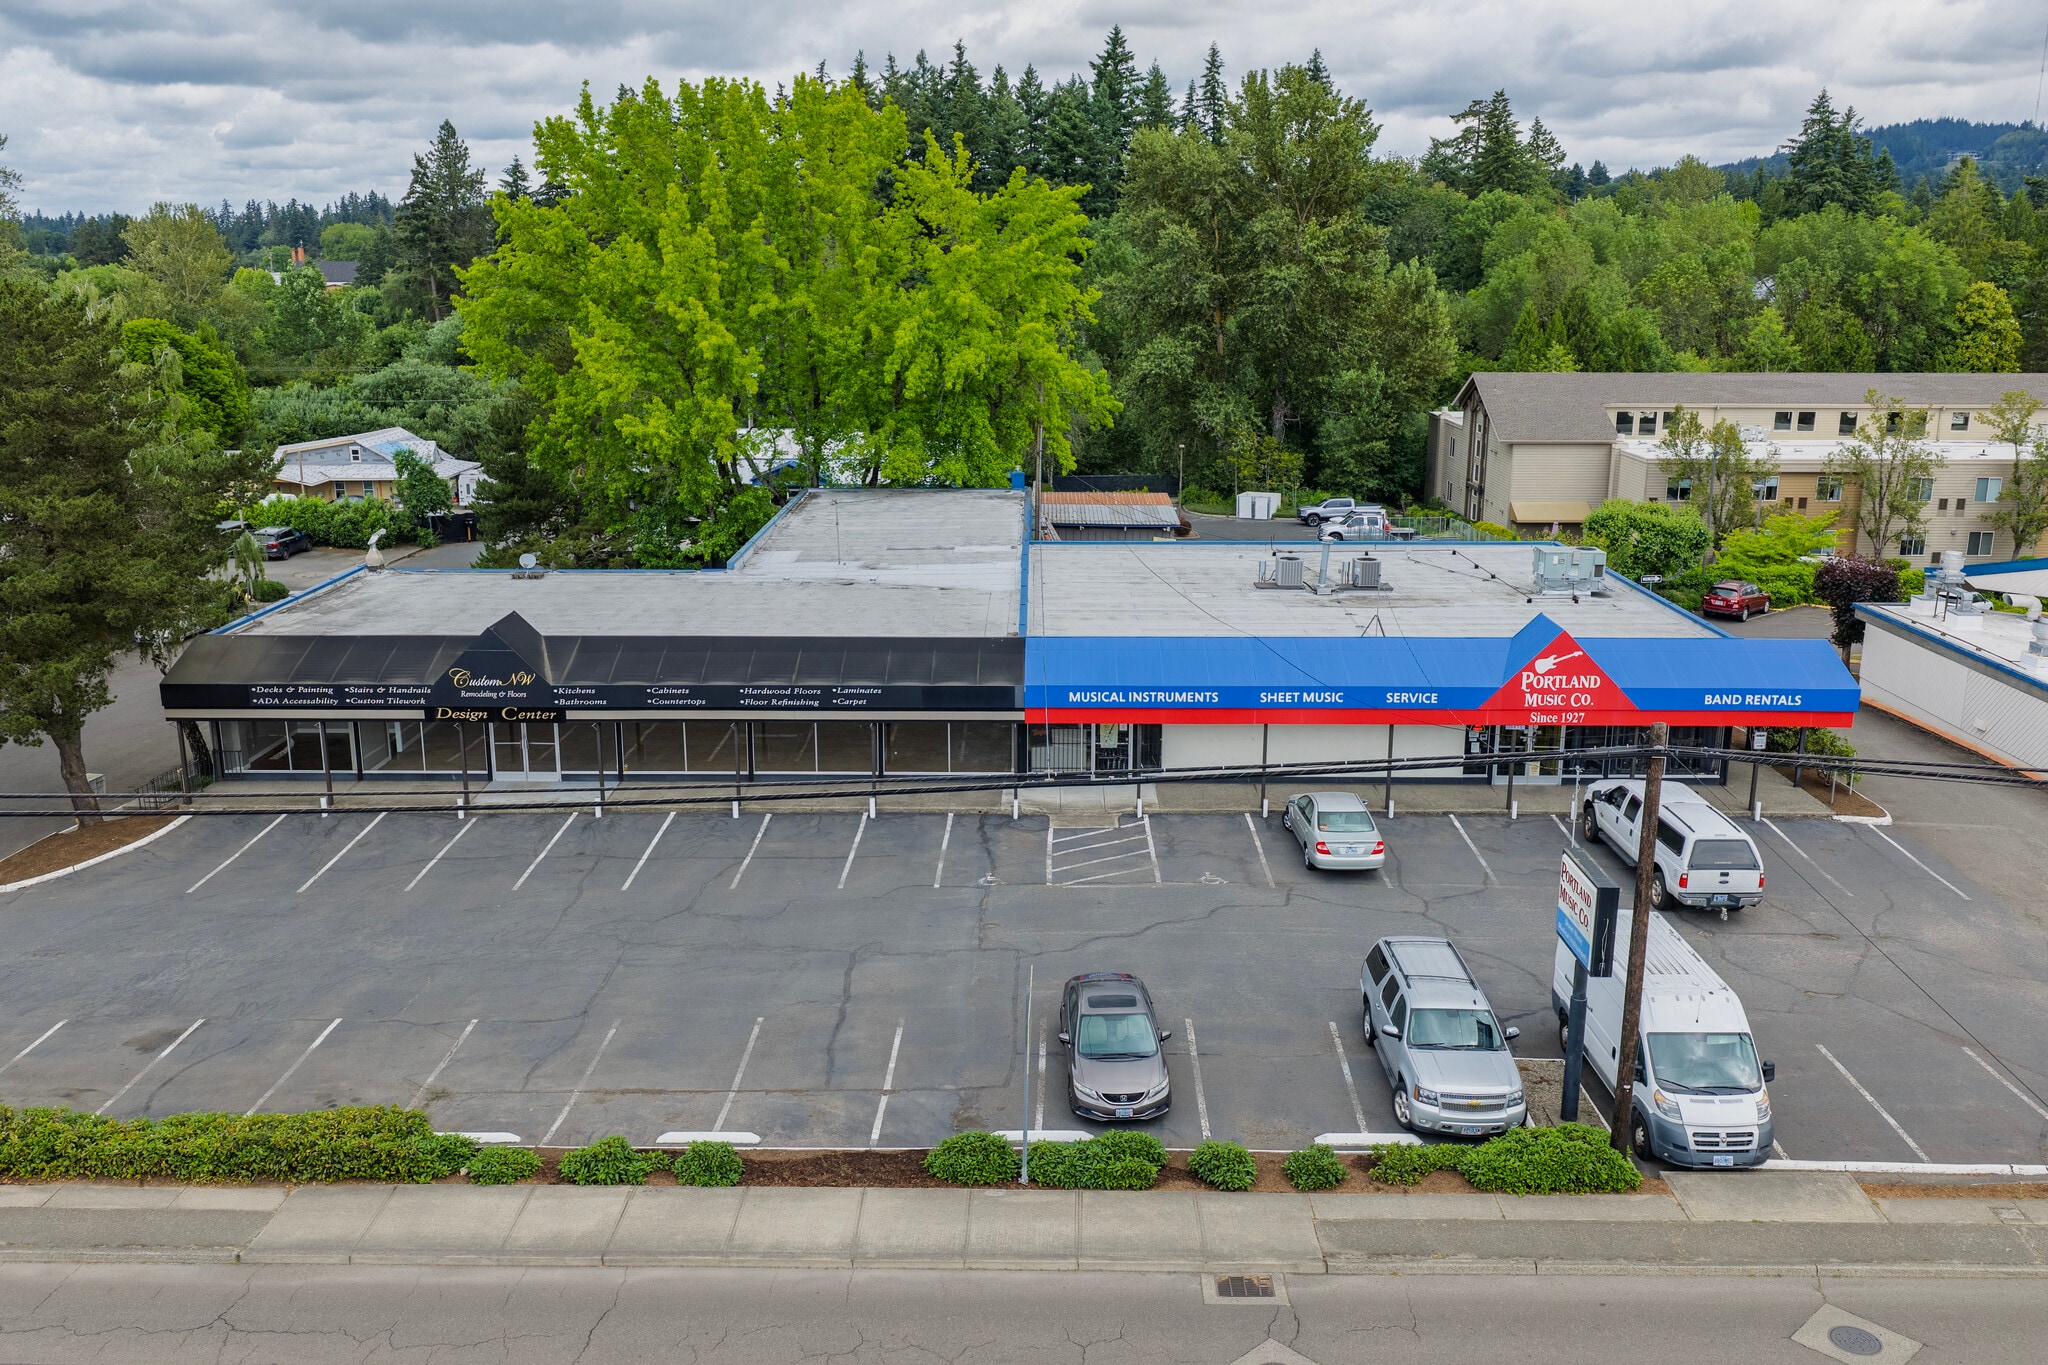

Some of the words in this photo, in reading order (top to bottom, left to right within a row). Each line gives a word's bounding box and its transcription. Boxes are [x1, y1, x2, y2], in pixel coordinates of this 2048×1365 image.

[448, 667, 500, 689] Custom
[500, 671, 536, 686] NW
[1520, 671, 1601, 692] PORTLAND
[298, 686, 334, 695] Painting
[349, 686, 374, 694] Stairs
[376, 686, 386, 694] &
[388, 686, 431, 694] Handrails
[460, 690, 498, 699] Remodeling
[499, 690, 506, 698] &
[507, 690, 527, 698] Floors
[558, 687, 596, 695] Kitchens
[651, 686, 690, 695] Cabinets
[744, 687, 791, 695] Hardwood
[794, 687, 821, 695] Floors
[837, 686, 882, 694] Laminates
[282, 698, 339, 706] Accessability
[386, 697, 426, 705] Tilework
[559, 698, 607, 706] Bathrooms
[652, 697, 706, 706] Countertops
[837, 697, 867, 706] Carpet
[1068, 692, 1126, 703] MUSICAL
[1128, 692, 1219, 703] INSTRUMENTS
[1259, 692, 1300, 704] SHEET
[1302, 692, 1344, 704] MUSIC
[1386, 692, 1438, 704] SERVICE
[1523, 693, 1567, 707] MUSIC
[1570, 692, 1595, 707] CO.
[1704, 694, 1743, 706] BAND
[1745, 694, 1802, 706] RENTALS
[744, 698, 769, 706] Floor
[771, 698, 819, 707] Refinishing
[436, 707, 488, 721] Design
[501, 706, 557, 720] Center
[1529, 712, 1558, 723] Since
[1561, 712, 1585, 723] 1927
[1561, 861, 1592, 908] PORTLAND
[1559, 883, 1578, 916] MUSIC
[1579, 907, 1589, 931] CO.
